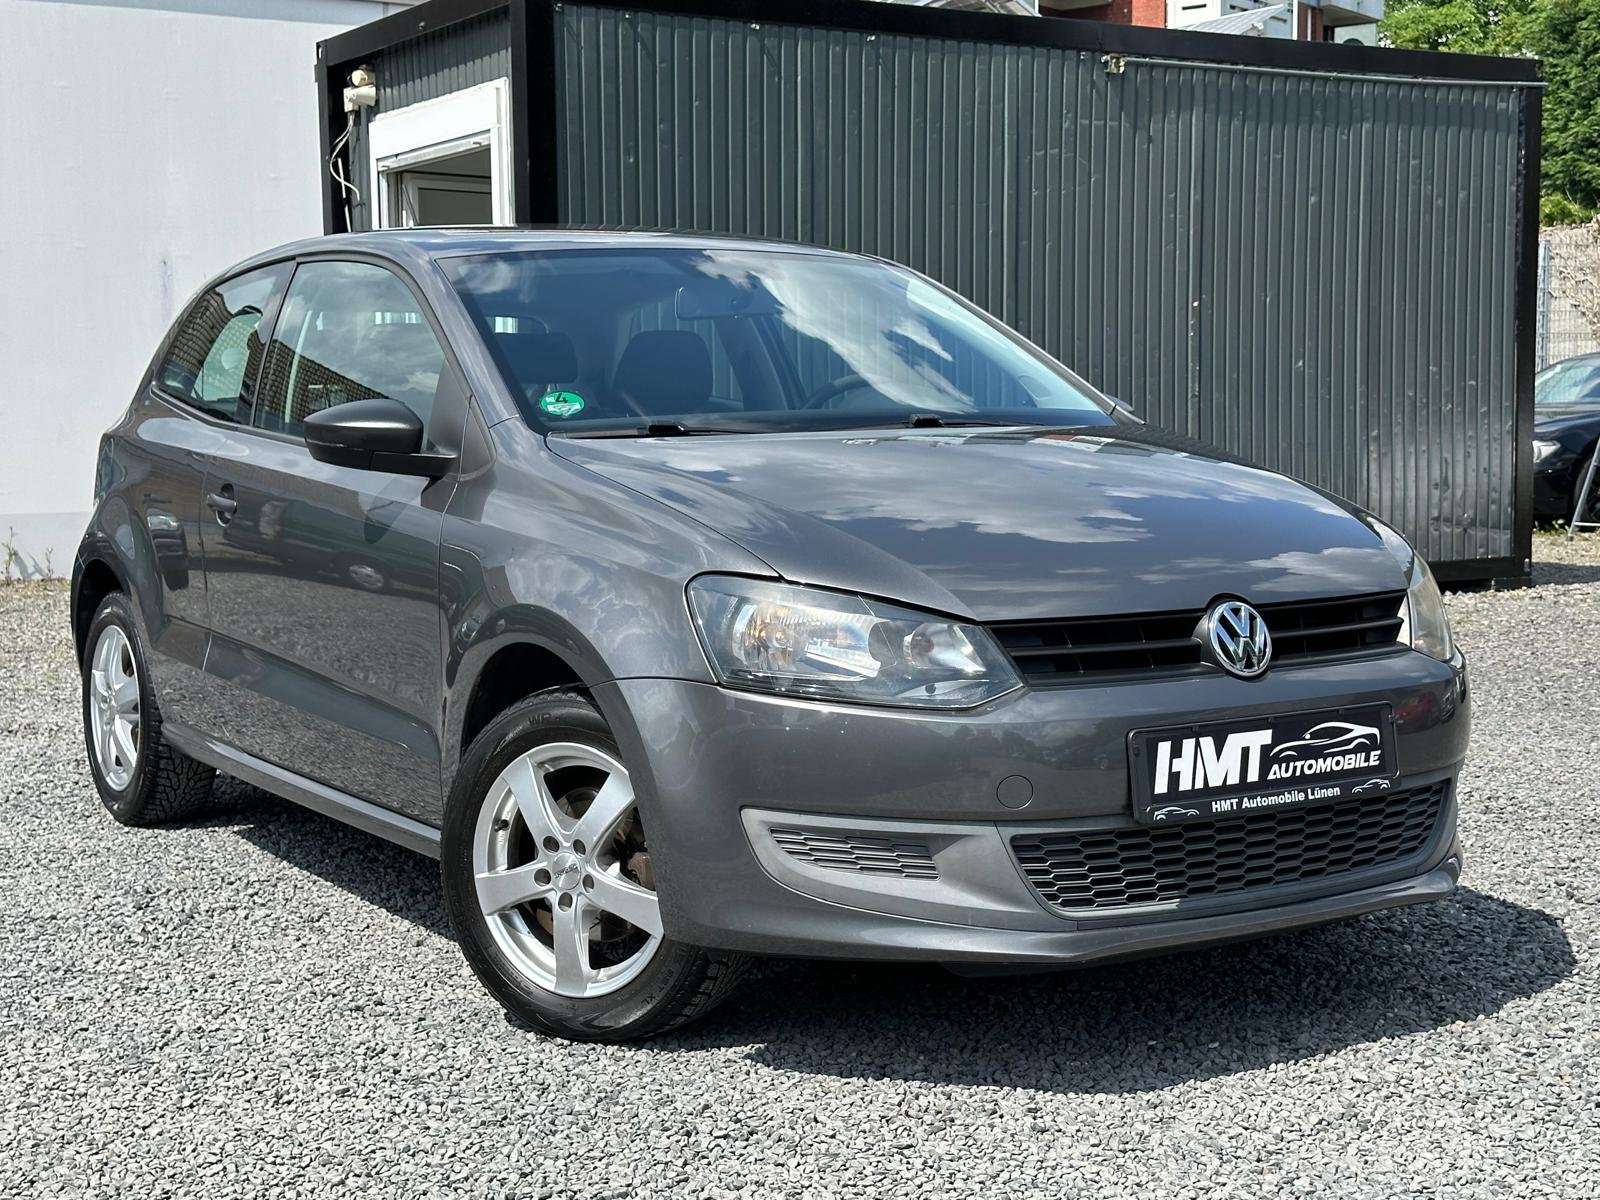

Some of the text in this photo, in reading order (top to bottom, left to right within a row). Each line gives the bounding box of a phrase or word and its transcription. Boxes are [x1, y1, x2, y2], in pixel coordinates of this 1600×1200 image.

[1211, 602, 1270, 675] VW
[1153, 729, 1273, 795] HMT
[1267, 750, 1381, 780] AUTOMOBILE
[1211, 786, 1341, 813] HMT Automobile Lünen
